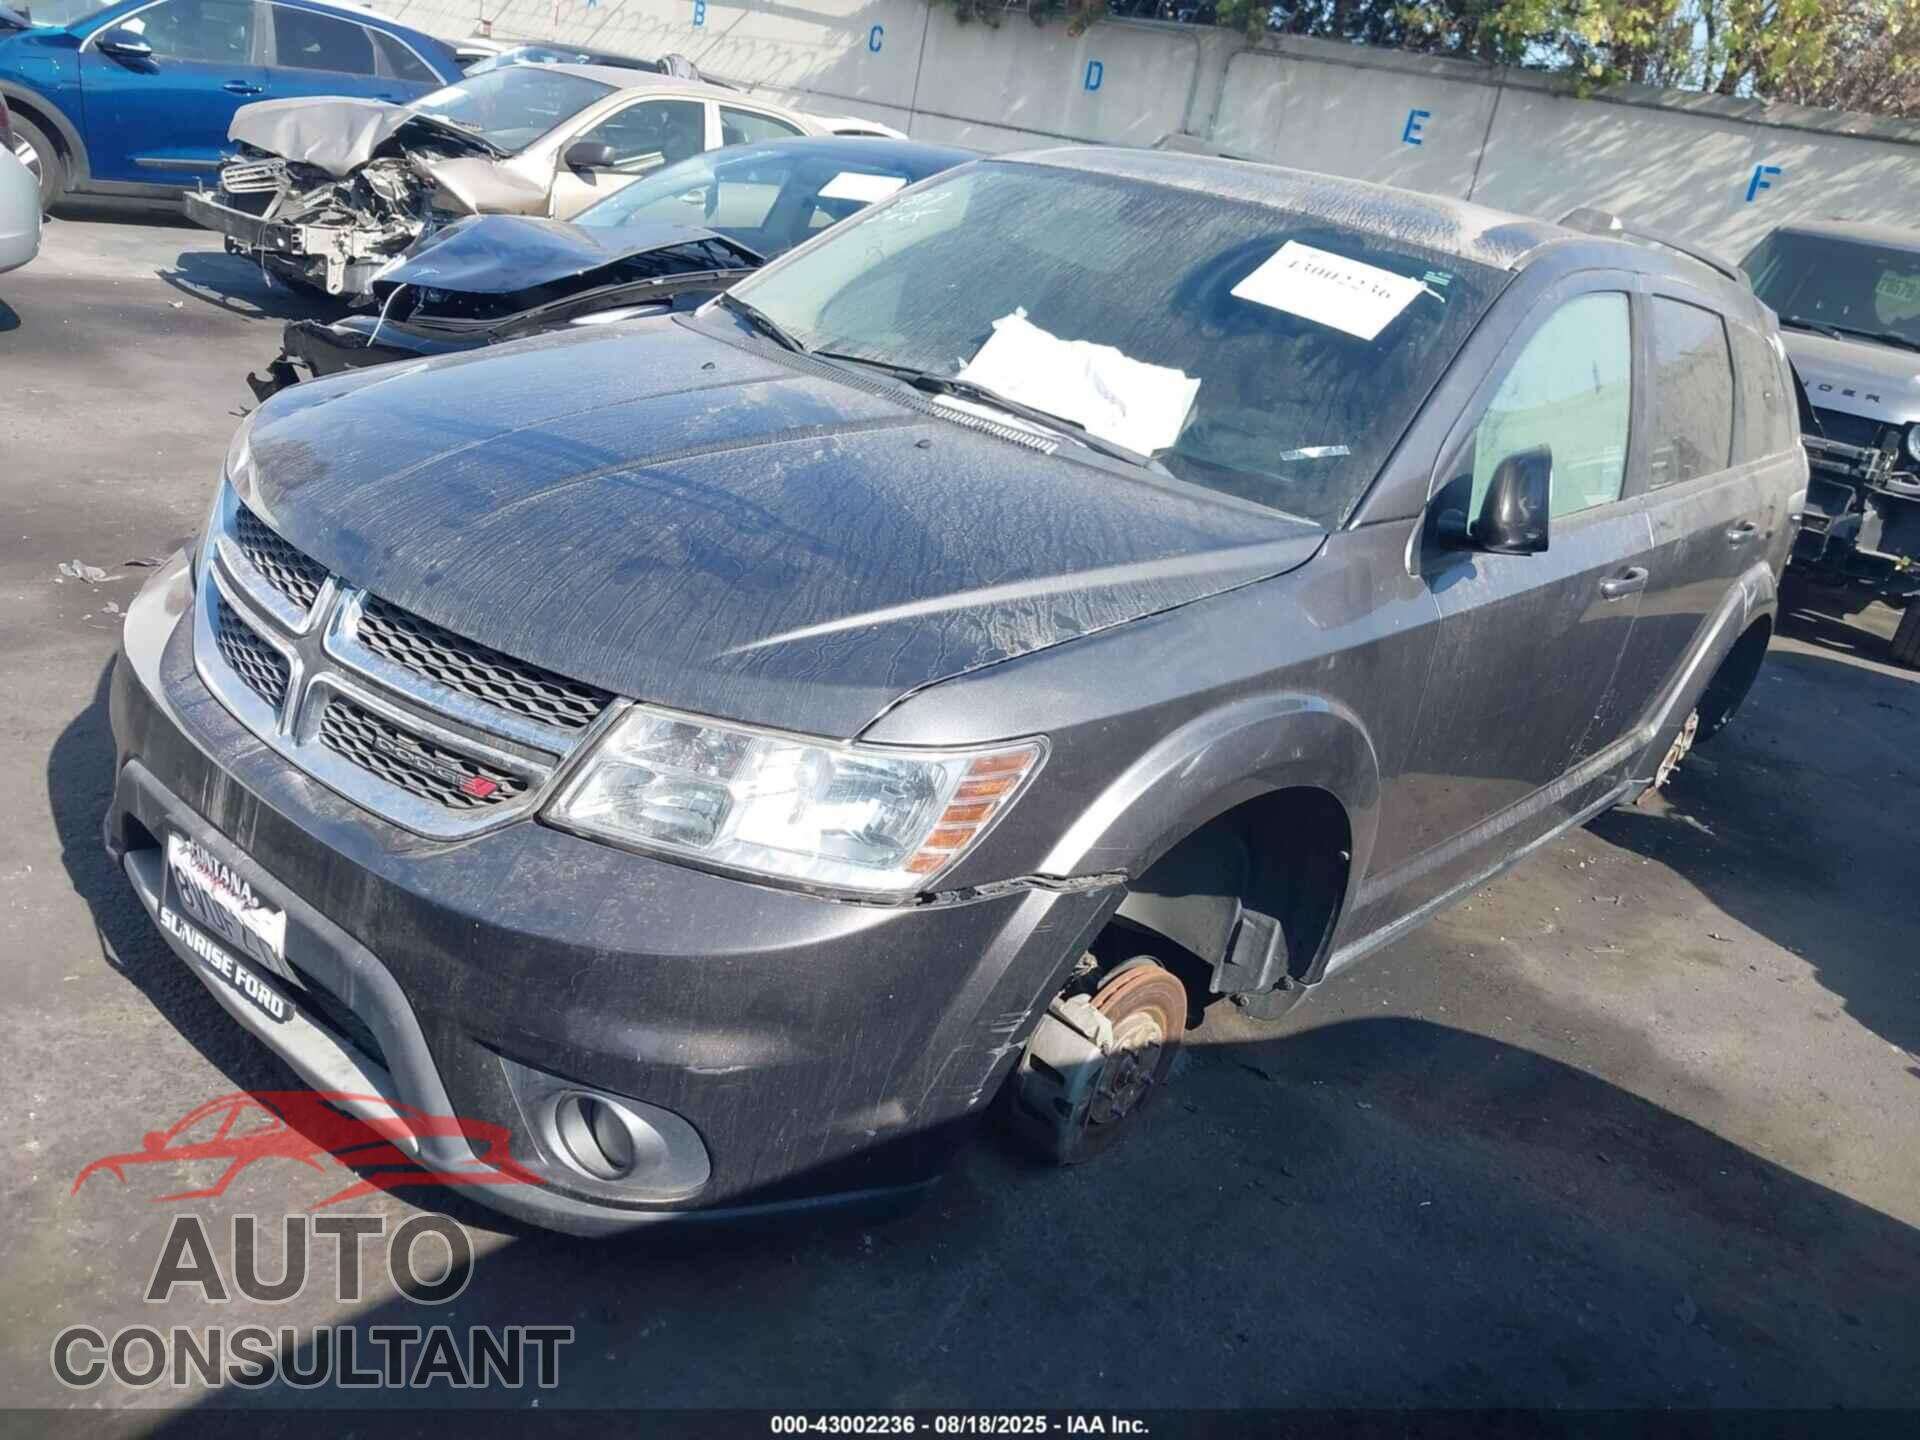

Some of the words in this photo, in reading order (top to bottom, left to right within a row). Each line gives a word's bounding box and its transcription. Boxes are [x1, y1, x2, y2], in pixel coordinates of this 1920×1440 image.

[693, 0, 706, 26] B
[869, 25, 884, 52] C
[1084, 60, 1104, 91] D
[1403, 110, 1431, 145] E
[1746, 165, 1782, 202] F
[160, 907, 233, 978] SUNRISE
[235, 965, 284, 1018] FORD
